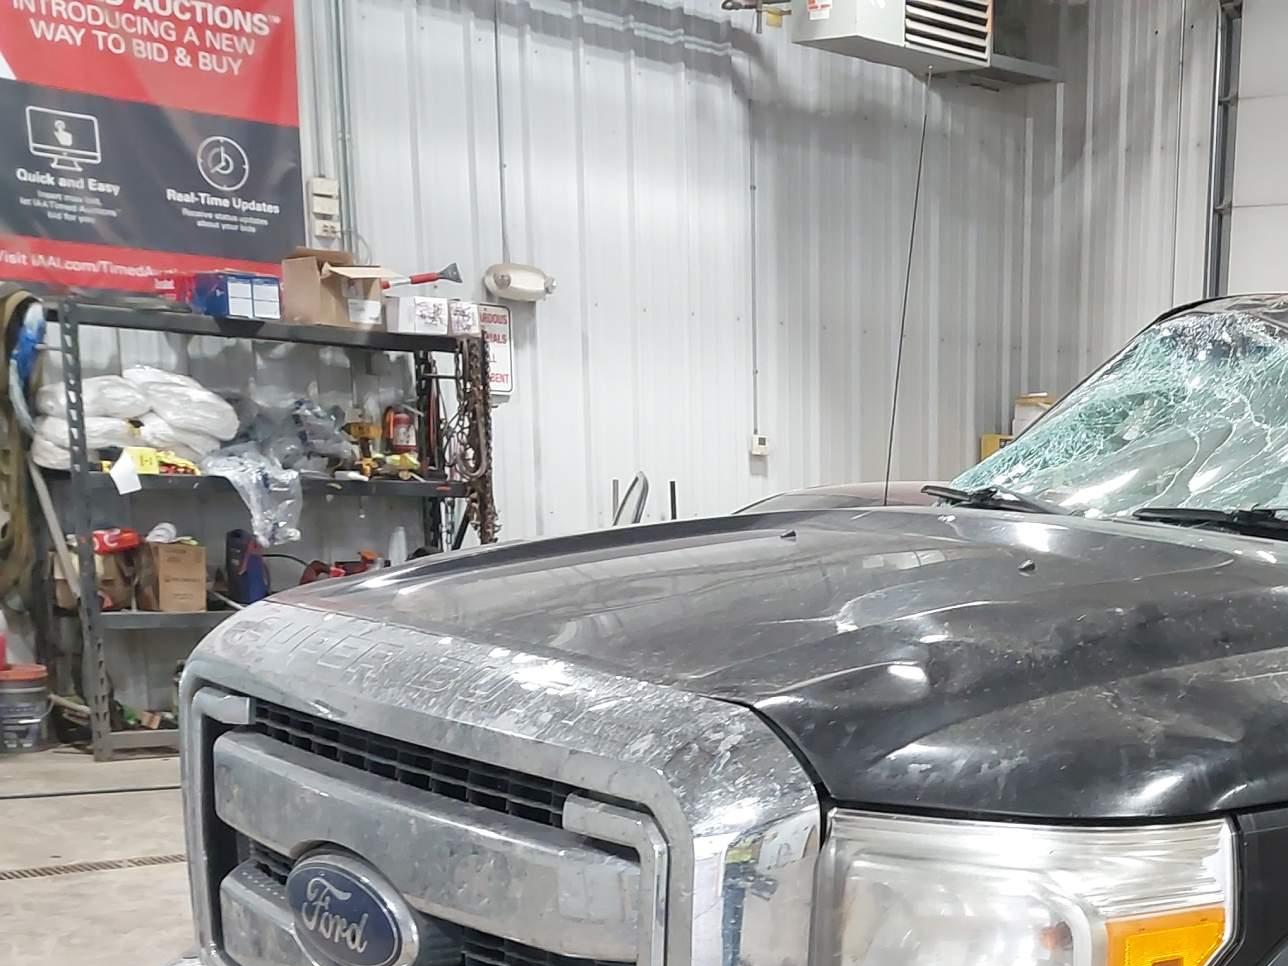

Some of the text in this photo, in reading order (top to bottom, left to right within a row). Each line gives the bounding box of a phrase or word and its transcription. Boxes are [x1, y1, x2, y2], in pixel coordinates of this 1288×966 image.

[29, 17, 243, 76] WAY TO BID & BUY
[183, 26, 200, 47] A
[205, 29, 256, 56] NEW
[16, 167, 121, 196] Quick and Easy
[166, 188, 281, 214] Real-Time Updates
[302, 877, 369, 953] Ford
